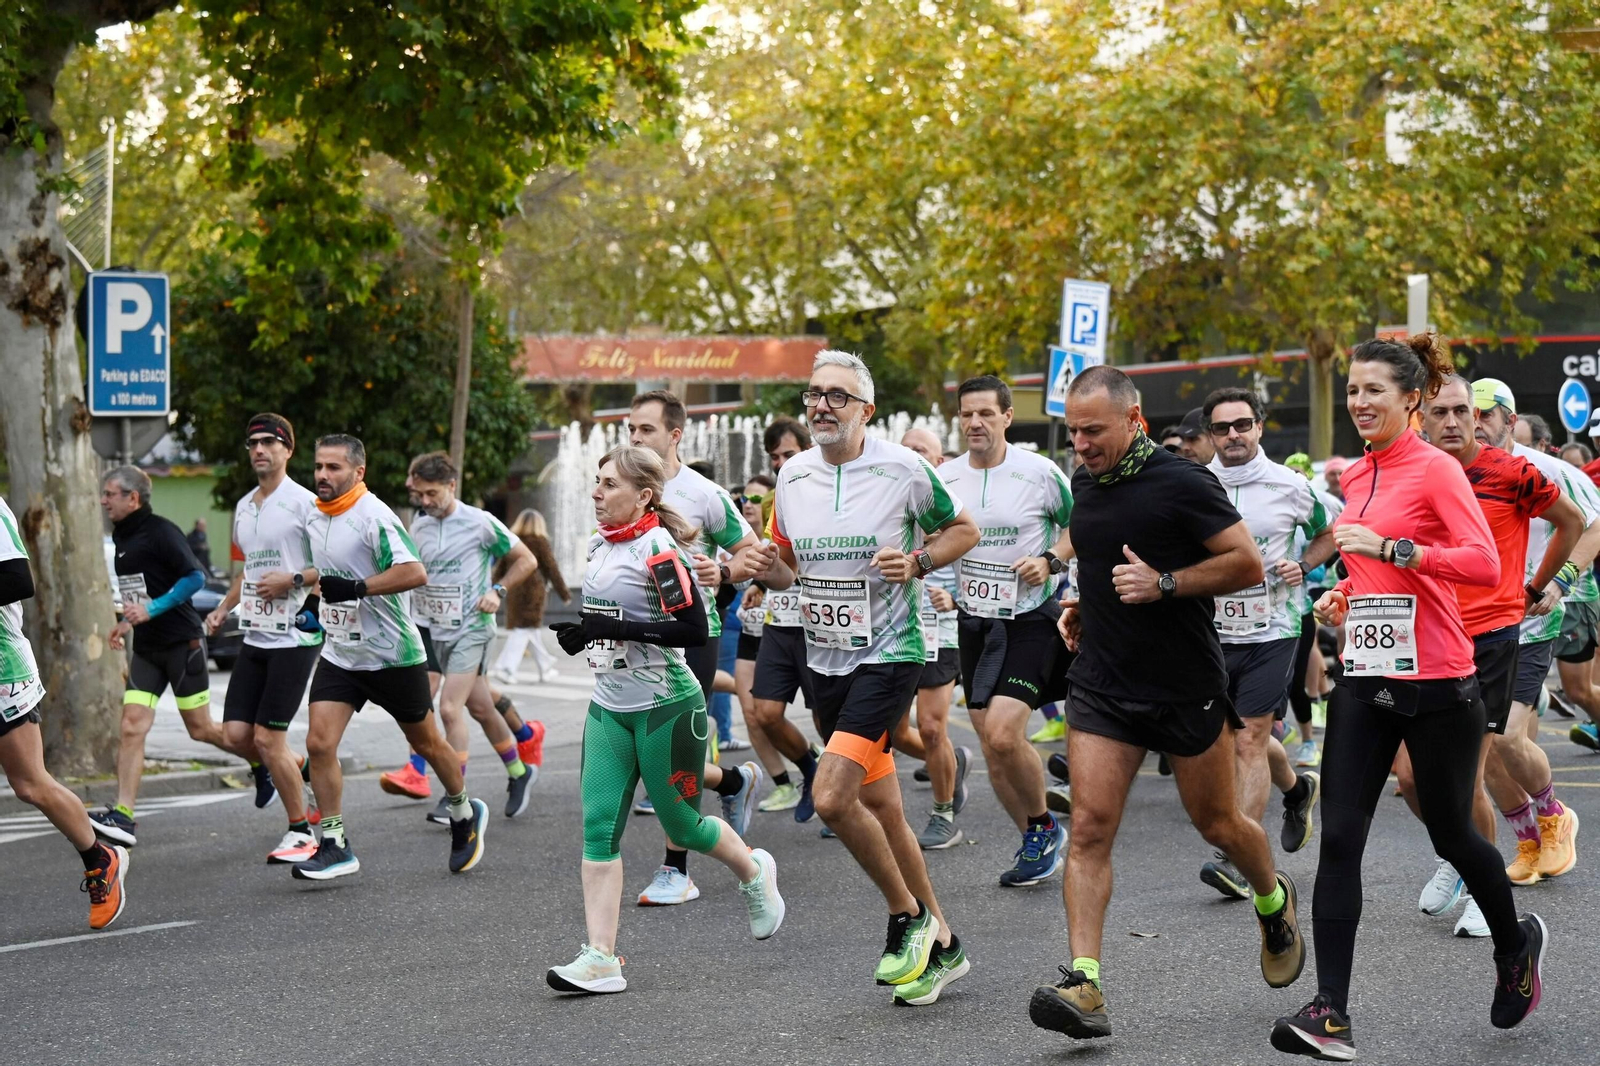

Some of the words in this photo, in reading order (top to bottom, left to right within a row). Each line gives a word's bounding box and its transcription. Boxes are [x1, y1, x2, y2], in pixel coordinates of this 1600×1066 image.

[106, 282, 153, 354] P
[1073, 305, 1095, 343] P
[579, 345, 637, 376] Feliz
[640, 347, 740, 369] Navidad
[101, 368, 128, 386] Parking
[129, 369, 139, 382] de
[111, 394, 117, 405] a
[117, 392, 131, 405] 100
[131, 393, 157, 406] metros
[868, 465, 885, 476] SIG
[979, 526, 1019, 537] UBIDA
[793, 538, 813, 550] XII
[816, 535, 878, 549] SUBIDA
[977, 538, 1017, 547] ERMITAS
[248, 549, 281, 561] SUBIDA
[799, 553, 805, 562] A
[806, 552, 825, 562] LAS
[827, 550, 876, 561] ERMITAS
[253, 560, 281, 568] ERMITAS
[967, 579, 1001, 601] 601
[254, 600, 274, 616] 50
[585, 595, 618, 607] SUBIDA
[773, 595, 799, 611] 592
[1224, 600, 1249, 618] 61
[325, 608, 348, 626] 137
[809, 602, 851, 628] 536
[1354, 623, 1395, 649] 688
